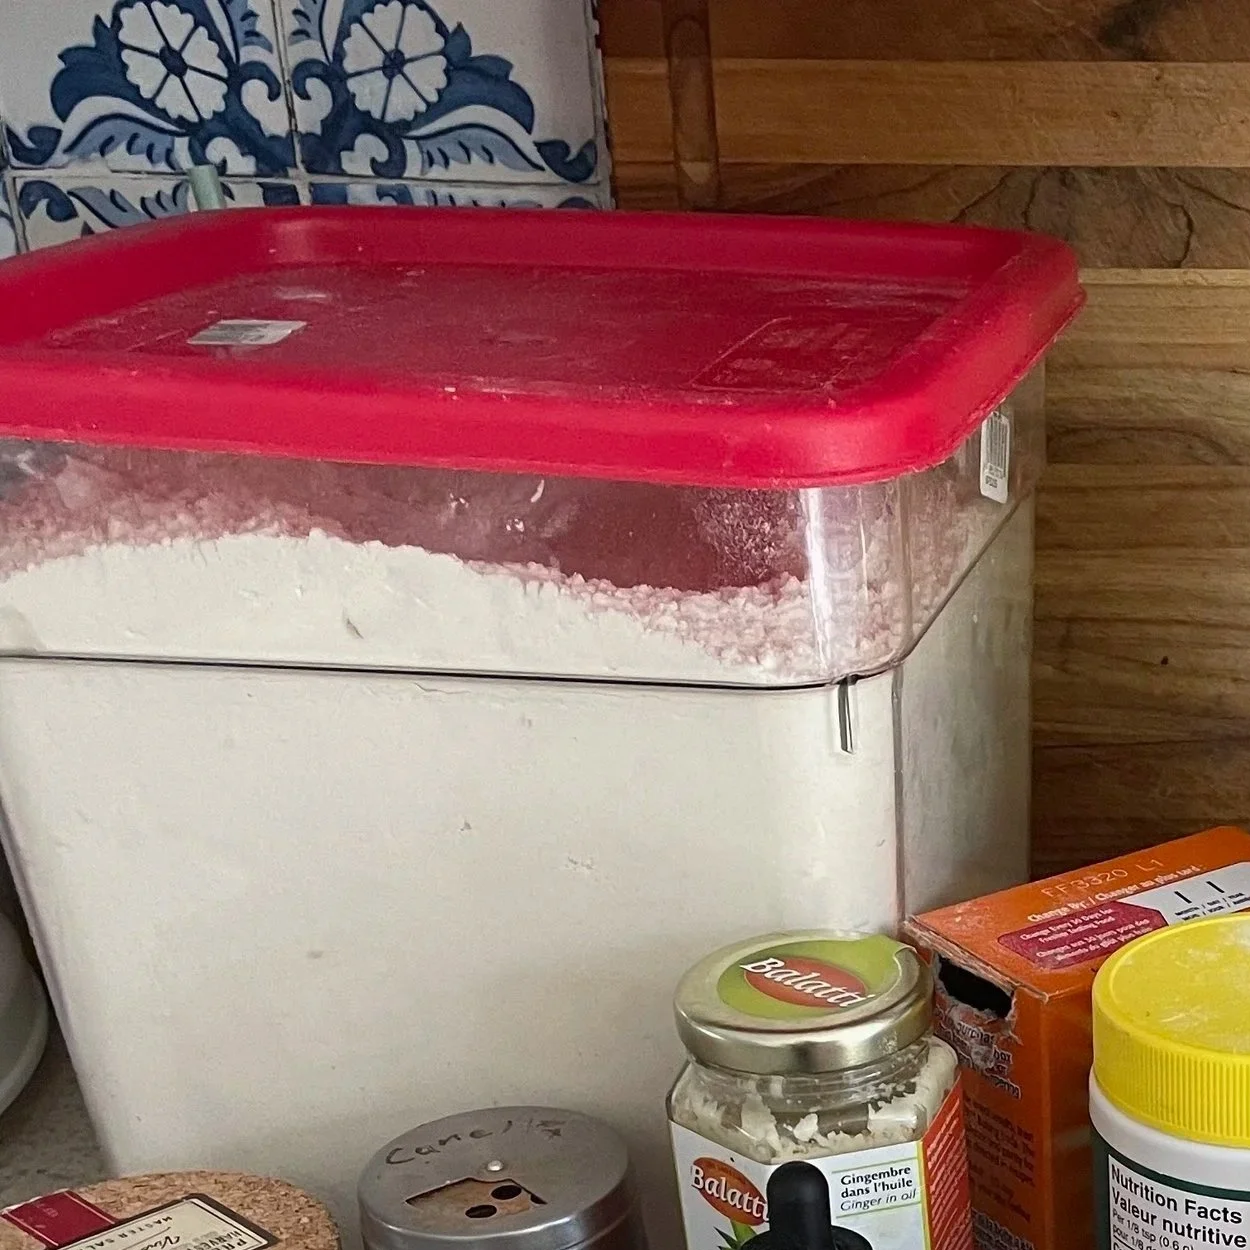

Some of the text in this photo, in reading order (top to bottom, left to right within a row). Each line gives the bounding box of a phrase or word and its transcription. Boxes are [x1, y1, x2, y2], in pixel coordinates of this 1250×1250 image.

[1041, 869, 1128, 897] FF3320
[1027, 907, 1071, 922] Change
[1095, 885, 1139, 901] Changer
[739, 957, 876, 1007] Balatti
[840, 1165, 911, 1186] Gingembre
[841, 1177, 913, 1199] dans l'huile
[840, 1188, 918, 1212] Ginger in oil
[1111, 1164, 1242, 1224] Nutrition Facts
[119, 1215, 174, 1239] MASTER
[1112, 1186, 1247, 1249] Valeur nutritive
[1112, 1208, 1125, 1224] Per
[1127, 1219, 1140, 1234] 1/8
[1142, 1228, 1156, 1243] tsp
[1113, 1224, 1129, 1241] pour
[1131, 1236, 1144, 1250] 1/8
